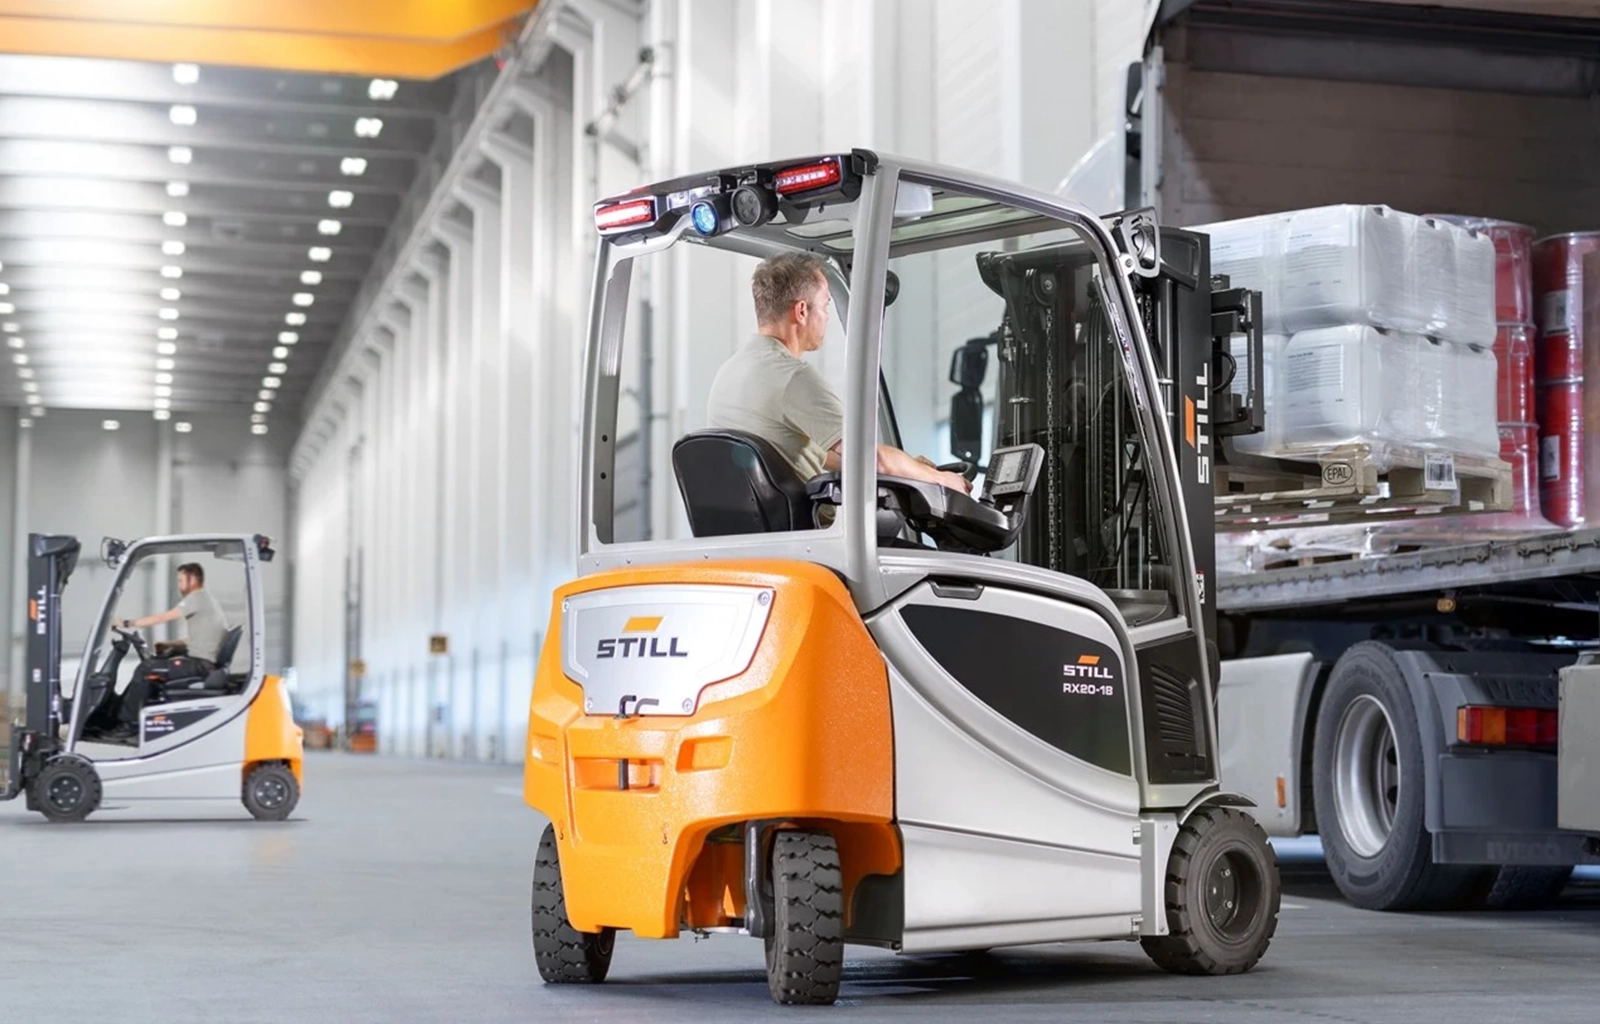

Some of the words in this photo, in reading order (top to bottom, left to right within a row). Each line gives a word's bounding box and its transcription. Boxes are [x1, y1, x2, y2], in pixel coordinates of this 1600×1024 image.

[1196, 362, 1210, 484] STILL
[1327, 463, 1349, 481] EPAL
[596, 636, 688, 659] STILL
[1063, 664, 1114, 679] STILL
[1063, 682, 1114, 696] RX20-18
